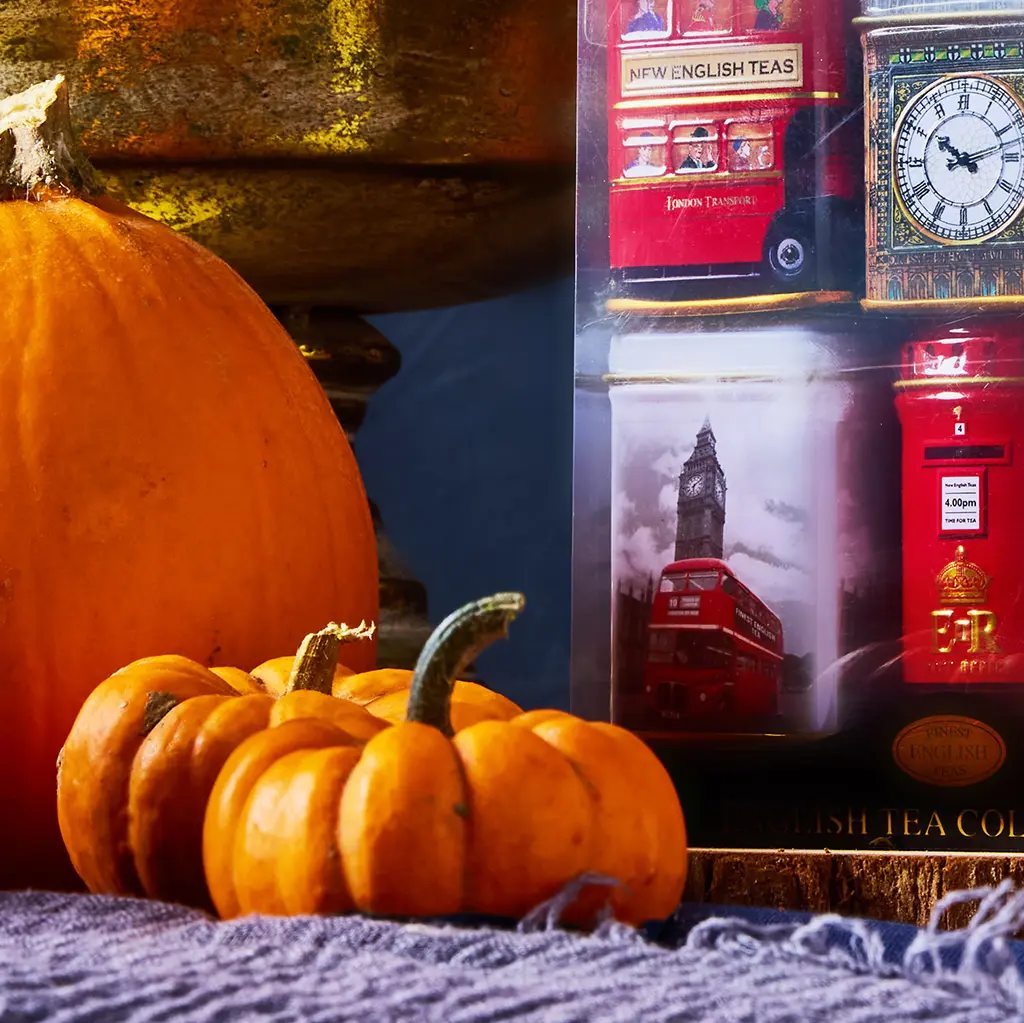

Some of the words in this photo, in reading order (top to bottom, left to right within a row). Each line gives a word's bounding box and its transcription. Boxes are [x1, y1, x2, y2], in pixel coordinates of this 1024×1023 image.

[630, 65, 667, 83] NEW
[671, 61, 745, 80] ENGLISH
[748, 58, 795, 76] TEAS
[945, 498, 977, 509] 4.00pm
[909, 744, 988, 760] ENGLISH
[881, 808, 947, 836] TEA
